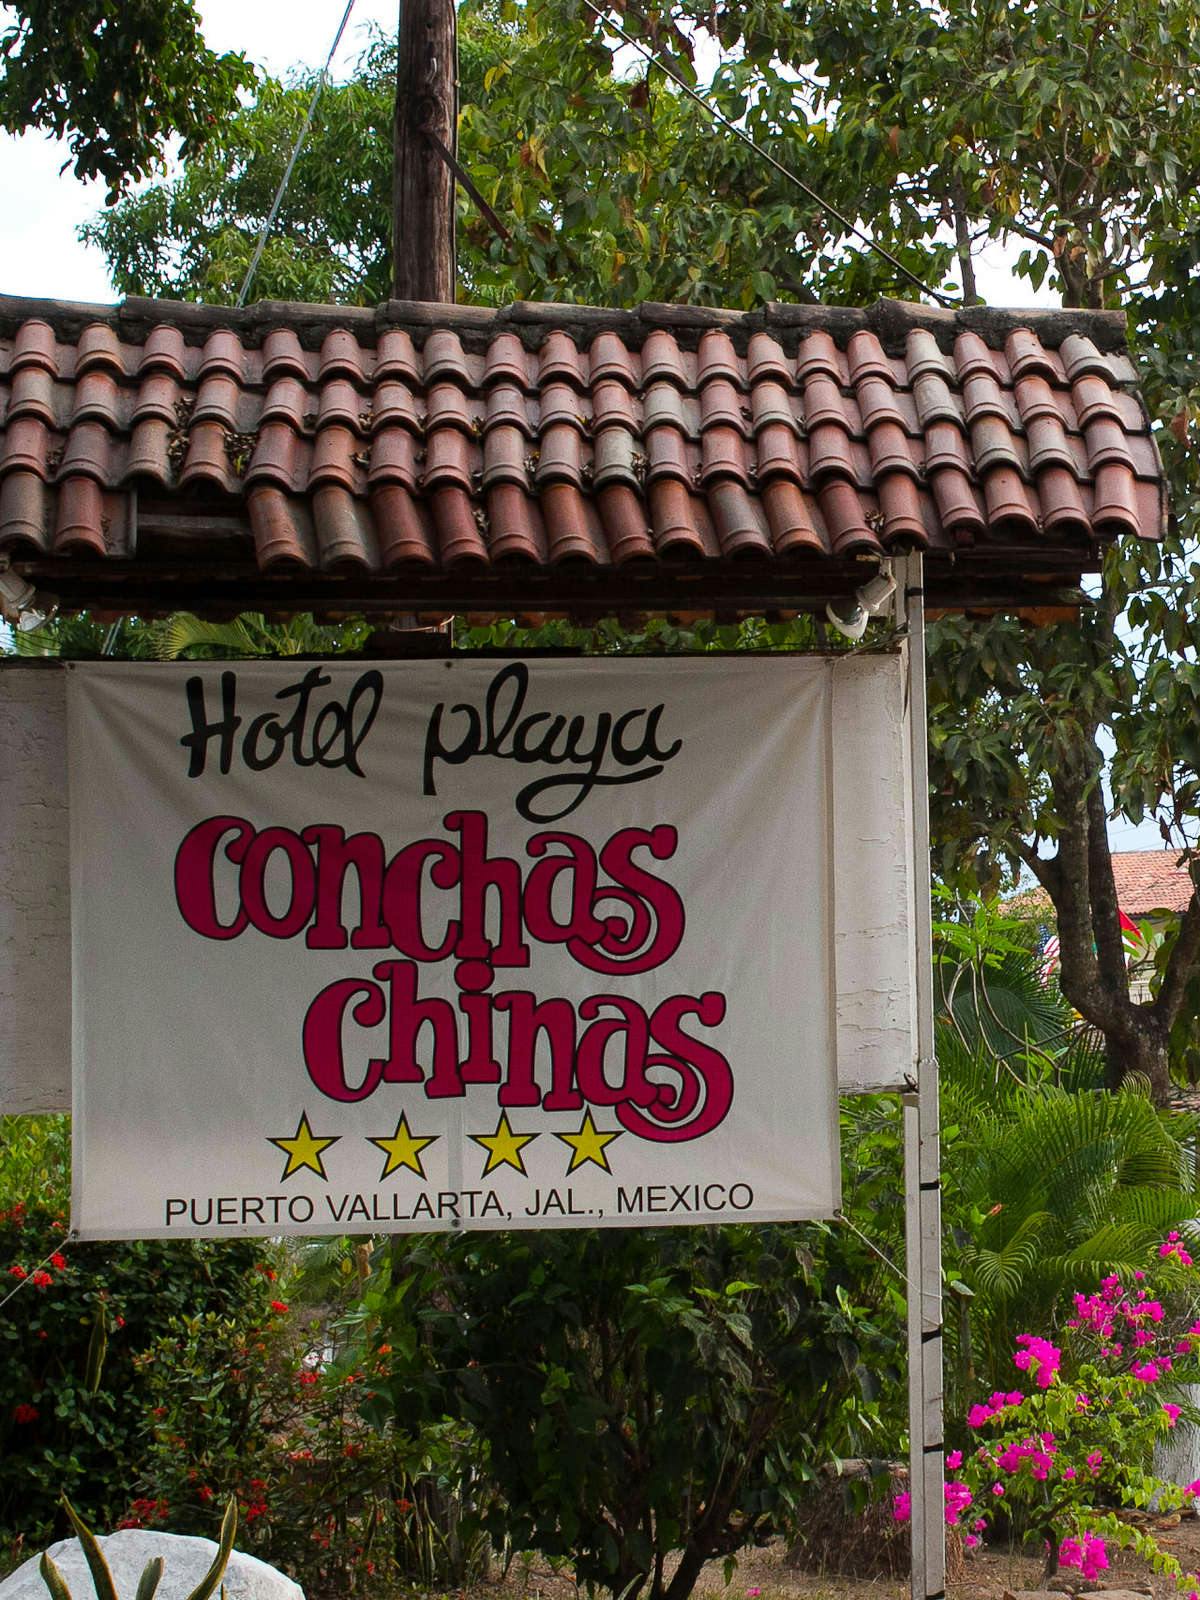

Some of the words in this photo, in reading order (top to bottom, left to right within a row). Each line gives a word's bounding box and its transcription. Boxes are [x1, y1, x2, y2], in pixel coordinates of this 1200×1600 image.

[180, 665, 385, 779] Hotel
[422, 661, 683, 825] playa
[164, 1194, 315, 1228] PUERTO
[325, 1189, 513, 1223] VALLARTA,
[524, 1187, 605, 1220] JAL.,
[616, 1182, 755, 1215] MEXICO
